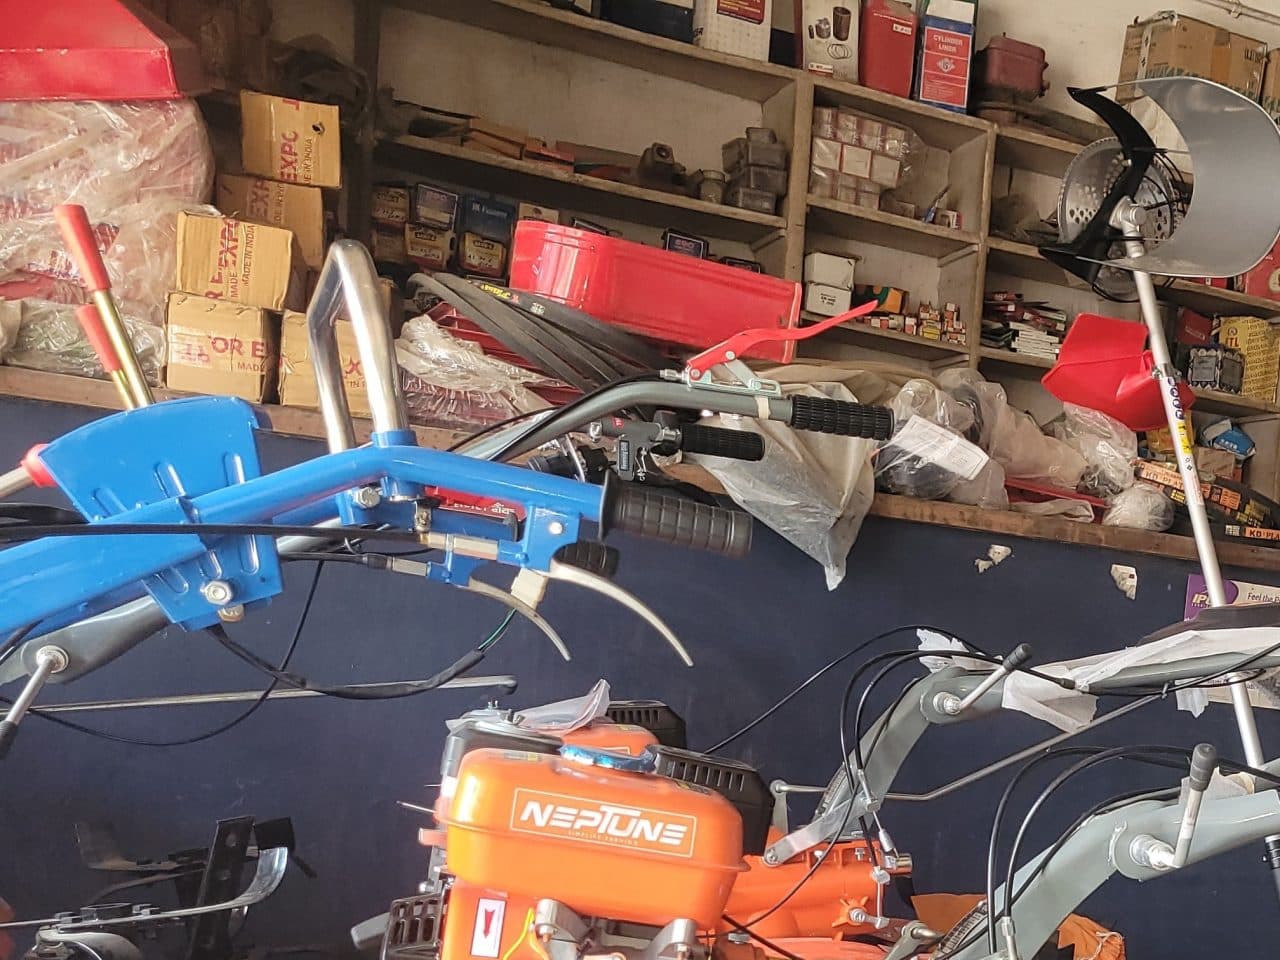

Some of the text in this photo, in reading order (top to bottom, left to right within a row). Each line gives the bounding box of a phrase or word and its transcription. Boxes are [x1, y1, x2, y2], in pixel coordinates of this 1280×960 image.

[1247, 591, 1262, 602] Feel
[1262, 593, 1273, 603] the
[519, 800, 688, 846] NEPTUNE
